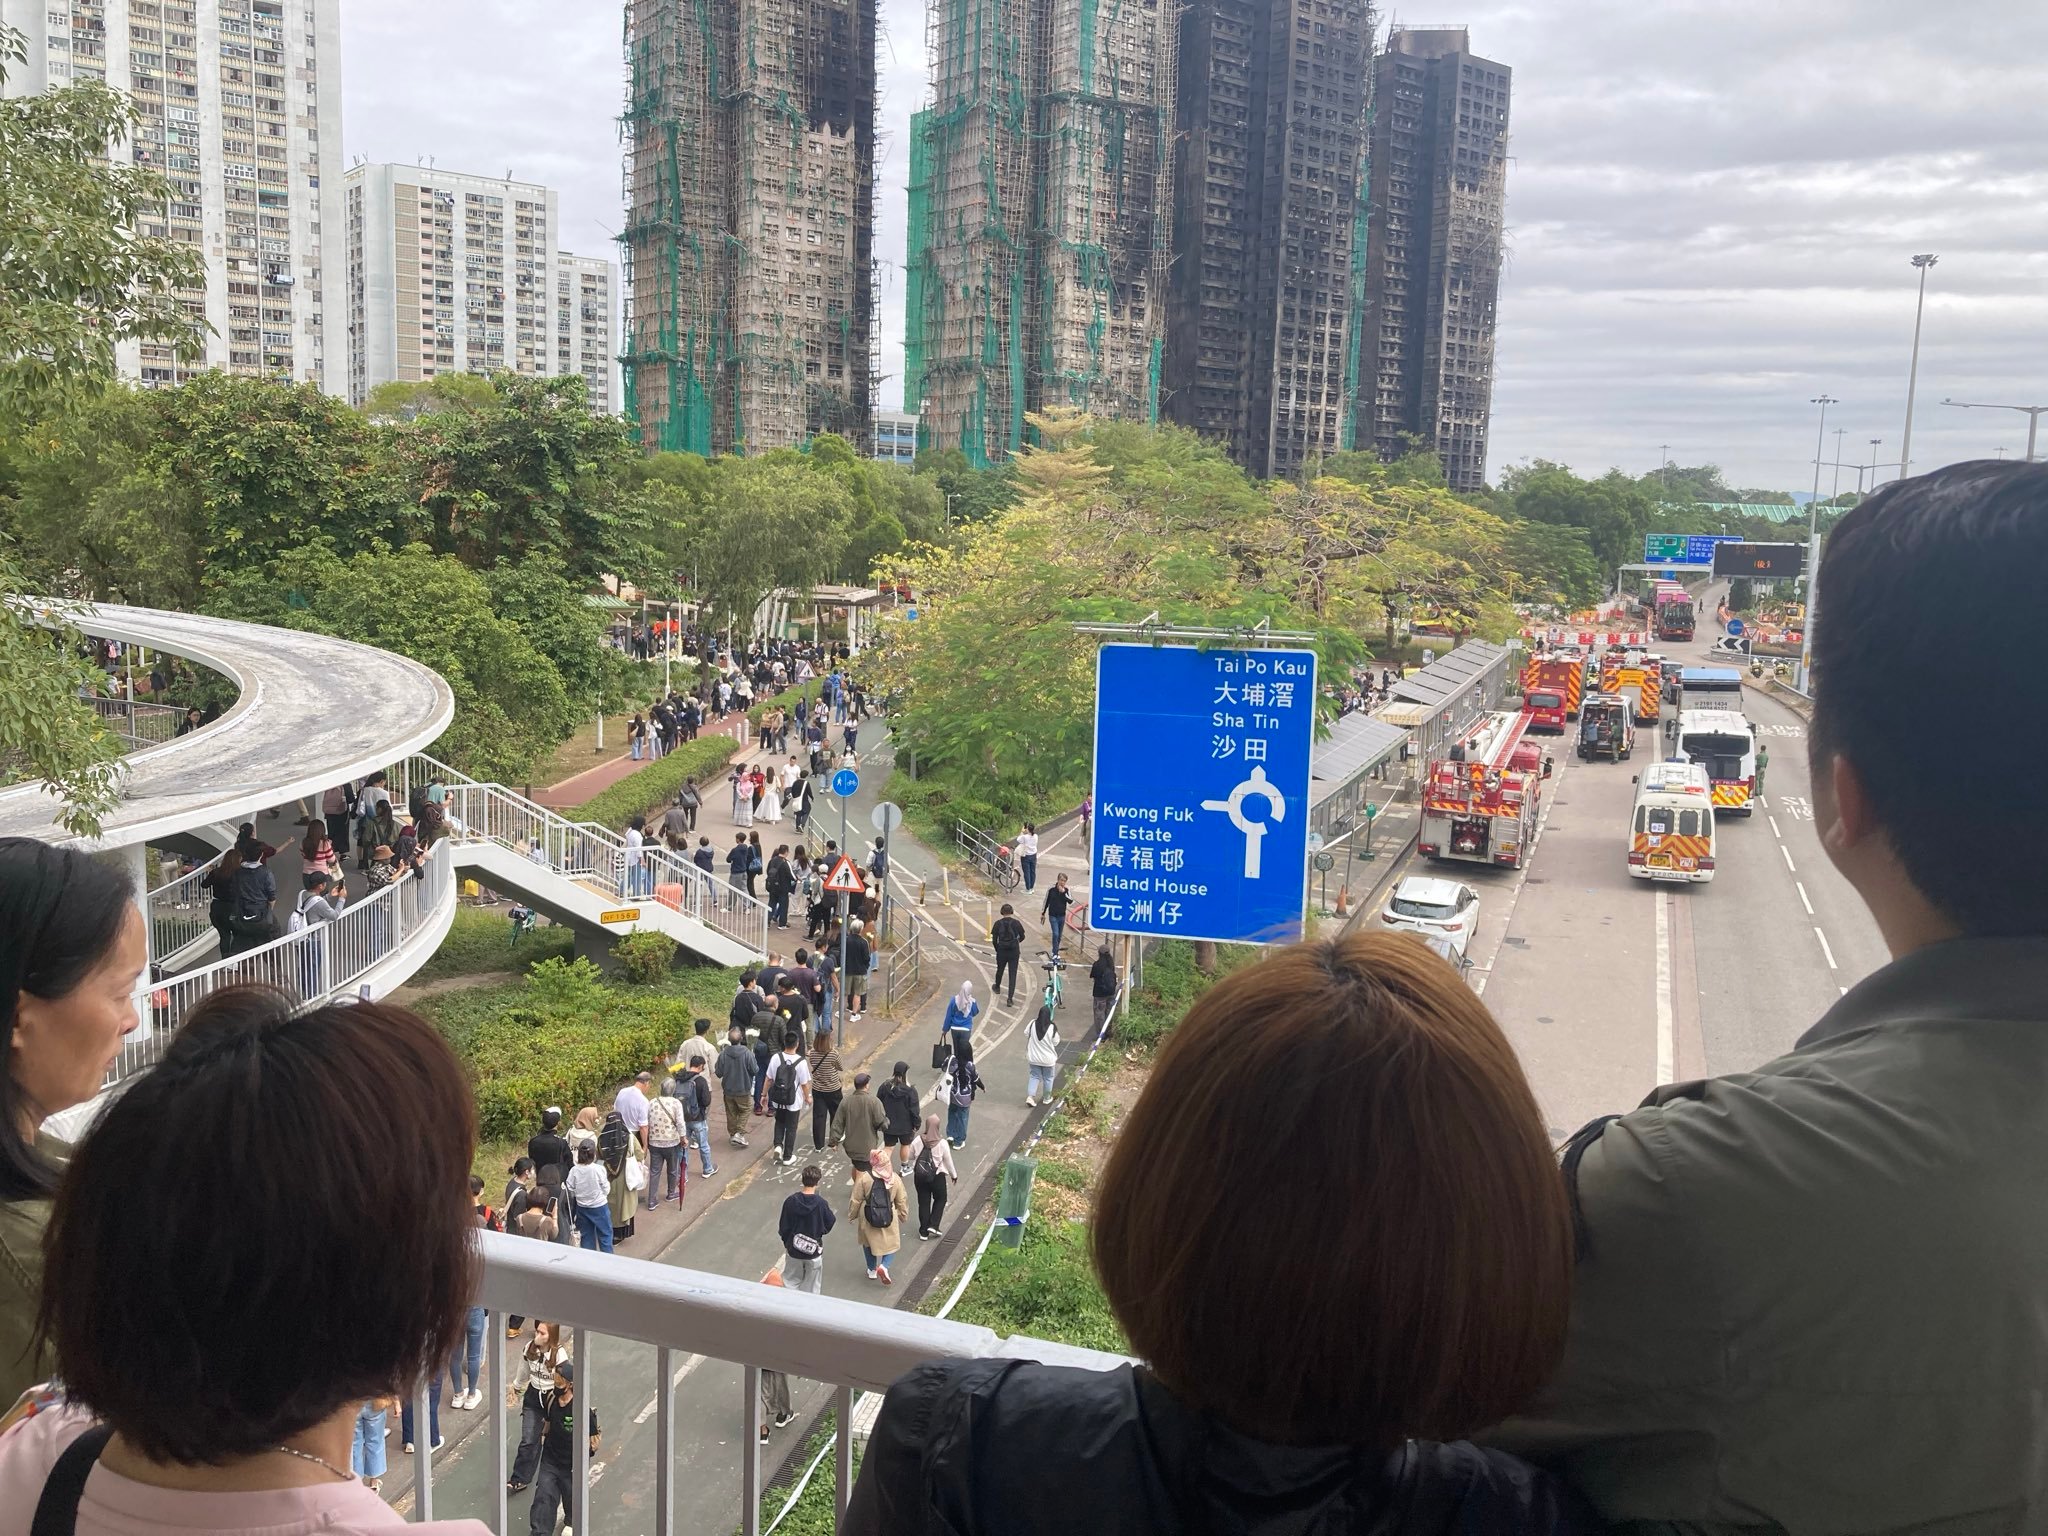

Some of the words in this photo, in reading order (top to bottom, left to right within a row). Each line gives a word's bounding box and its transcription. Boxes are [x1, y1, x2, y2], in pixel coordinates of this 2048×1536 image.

[1214, 657, 1239, 673] Tai
[1245, 658, 1267, 674] Po
[1274, 659, 1307, 676] Kau
[1213, 681, 1294, 709] 大埔滘
[1212, 711, 1244, 728] Sha
[1252, 713, 1279, 729] Tin
[1211, 734, 1267, 762] 沙田
[1103, 802, 1158, 823] Kwong
[1164, 806, 1194, 822] Fuk
[1118, 824, 1172, 842] Estate
[1101, 843, 1184, 872] 廣福邨
[1100, 874, 1149, 891] Island
[1155, 878, 1208, 896] House
[1099, 897, 1183, 925] 元洲仔
